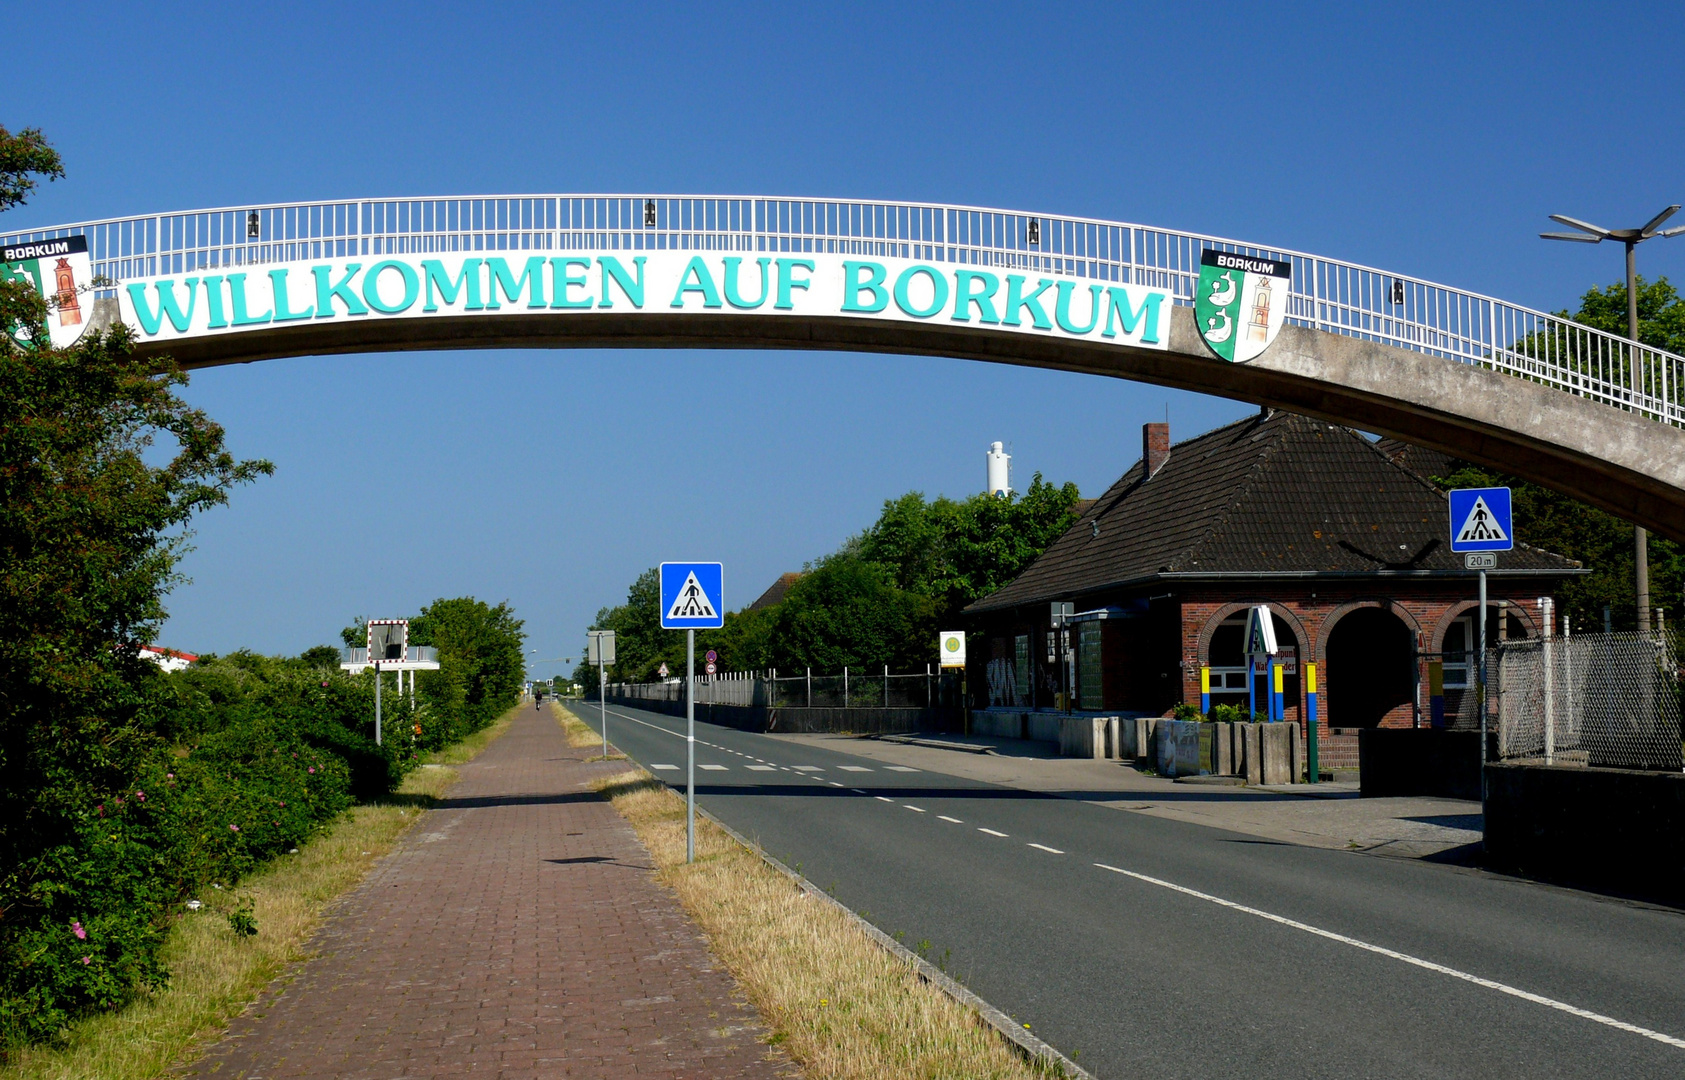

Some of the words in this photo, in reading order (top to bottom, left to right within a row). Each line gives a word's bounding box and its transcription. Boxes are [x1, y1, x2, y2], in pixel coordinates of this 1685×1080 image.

[5, 242, 69, 260] BORKUM
[1217, 255, 1274, 274] BORKUM
[126, 256, 648, 334] WILLKOMMEN
[670, 256, 815, 310] AUF
[840, 260, 1165, 343] BORKUM
[1470, 556, 1482, 565] 20
[1483, 558, 1492, 566] m
